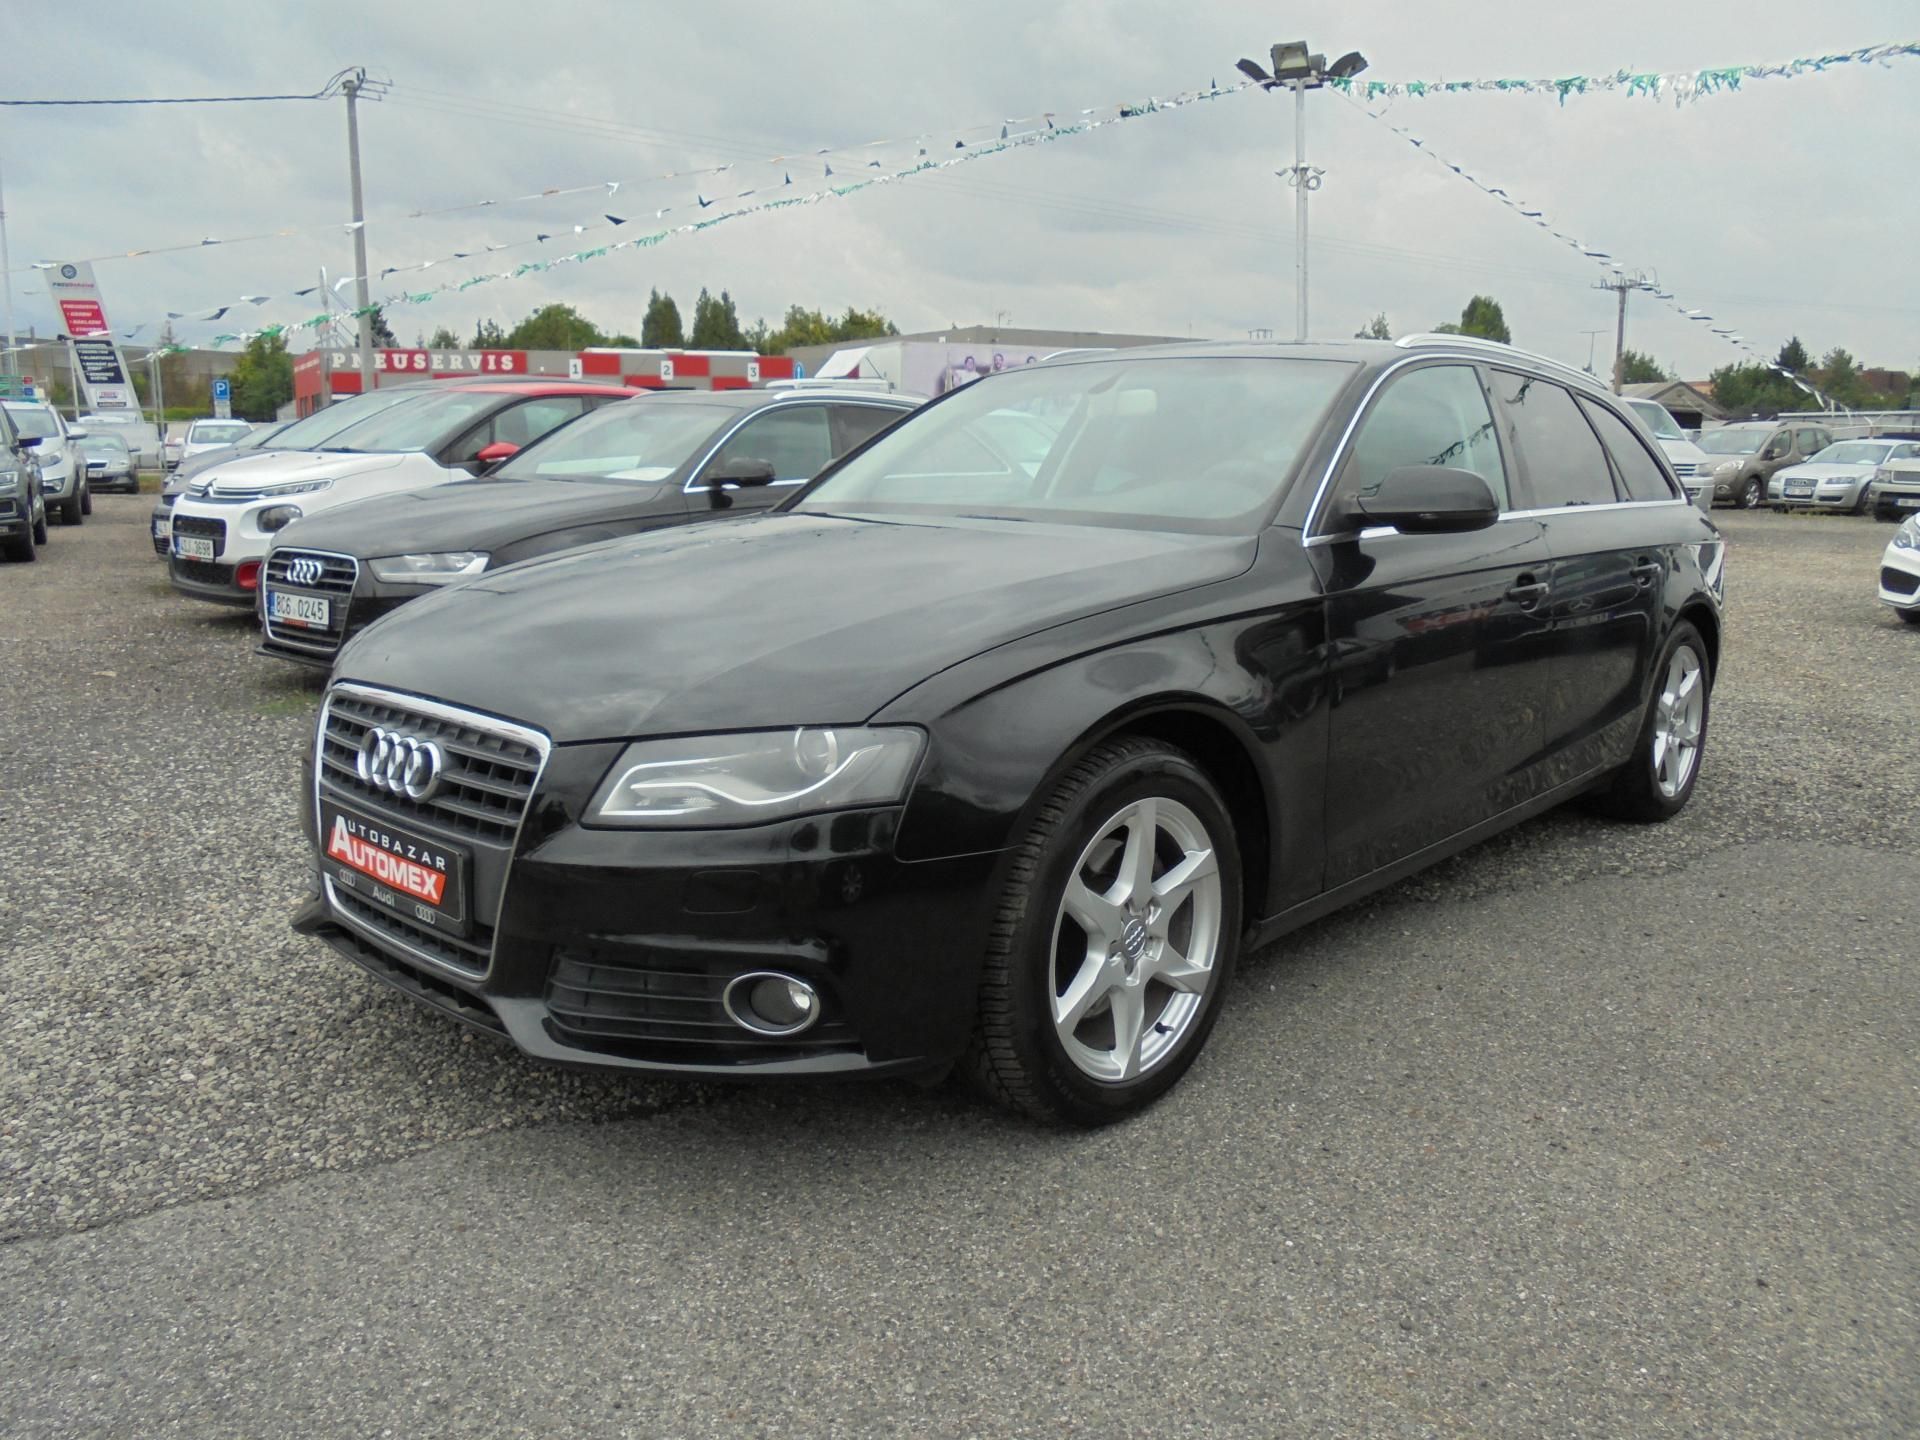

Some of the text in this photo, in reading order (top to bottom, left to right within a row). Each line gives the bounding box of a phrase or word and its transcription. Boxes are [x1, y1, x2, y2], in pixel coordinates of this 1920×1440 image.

[572, 364, 579, 375] 1
[663, 365, 671, 376] 2
[750, 366, 757, 377] 3
[216, 382, 226, 395] P
[297, 599, 324, 620] 0245
[331, 815, 439, 900] AUTOMEX
[373, 886, 395, 907] Audi
